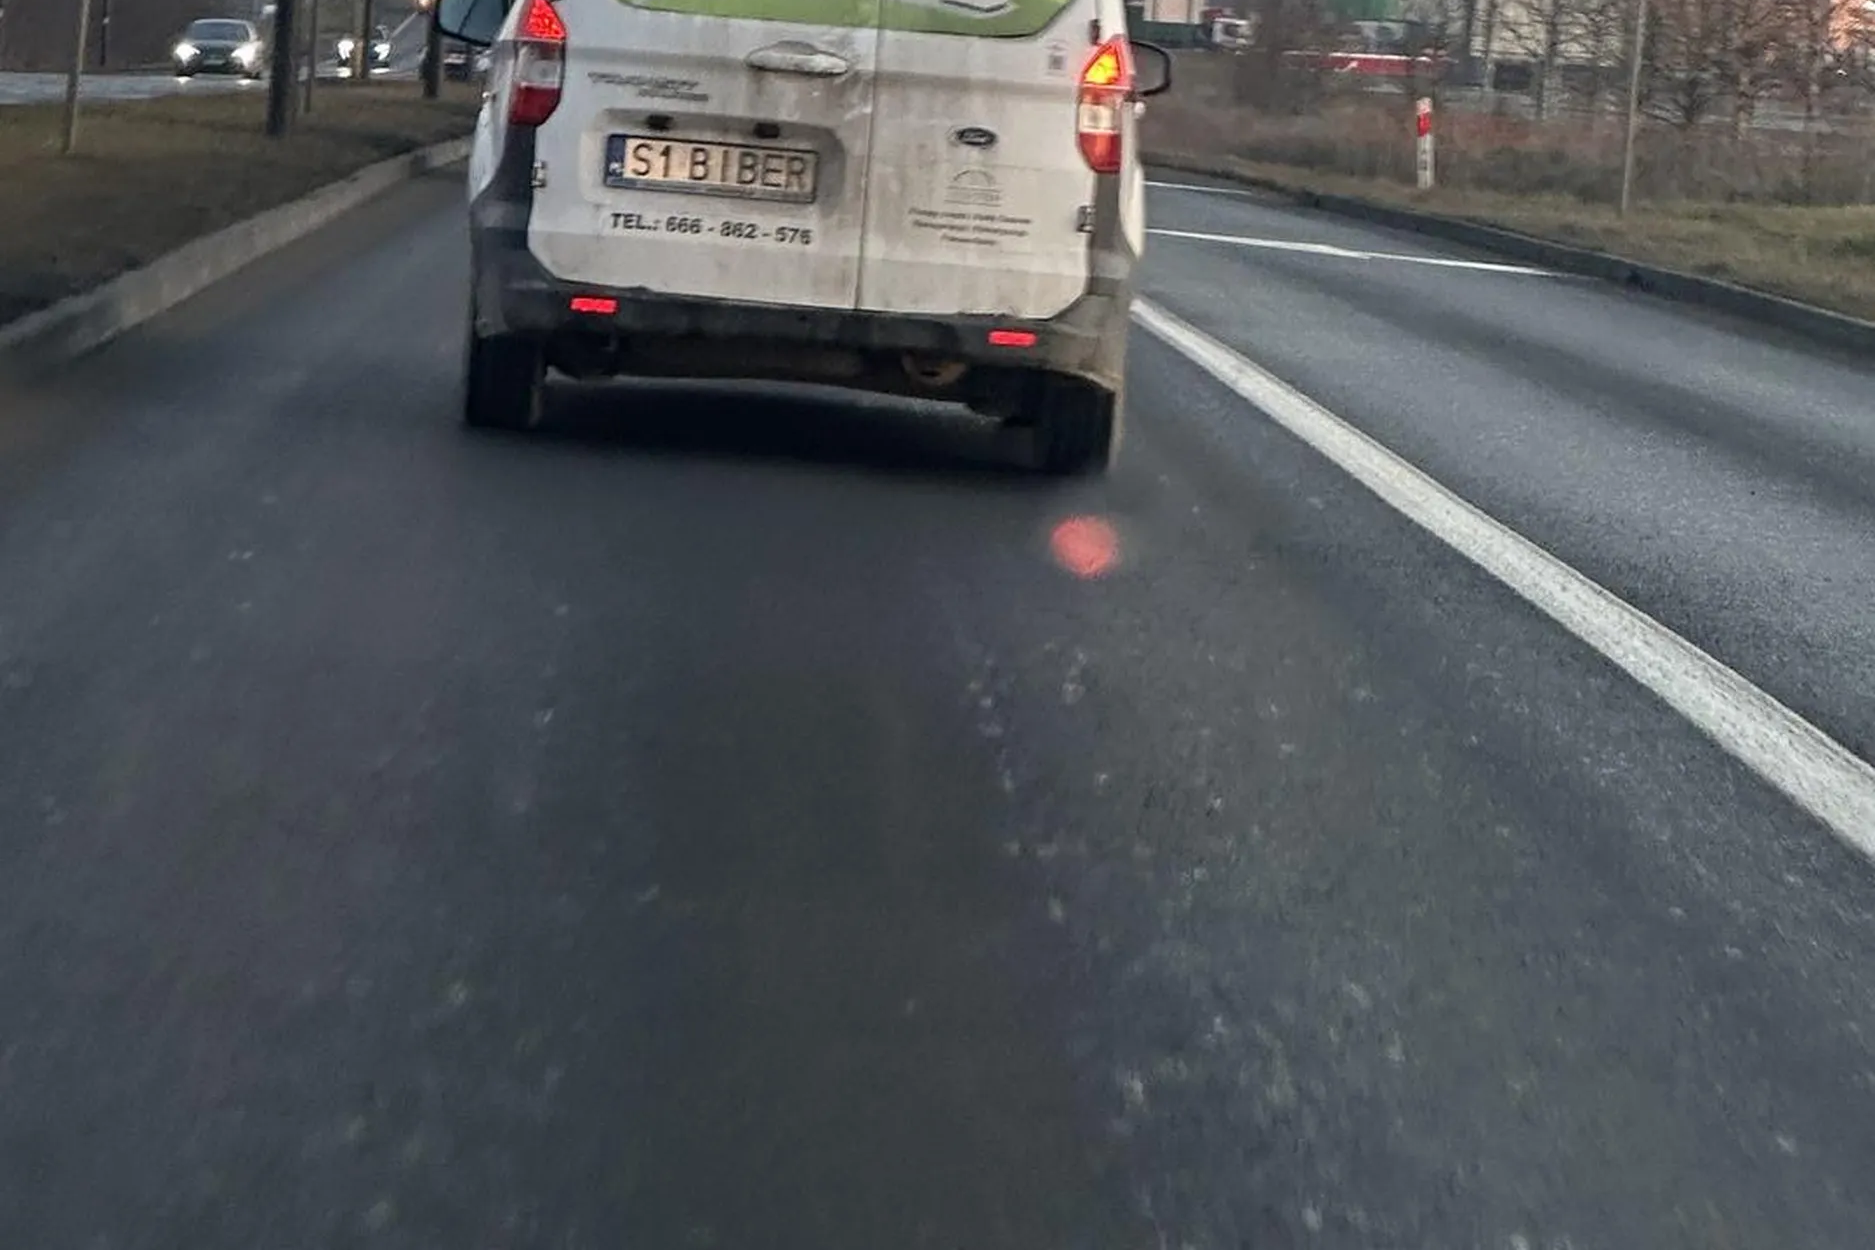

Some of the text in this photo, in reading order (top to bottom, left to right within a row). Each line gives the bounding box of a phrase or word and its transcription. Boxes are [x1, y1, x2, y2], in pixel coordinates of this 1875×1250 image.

[632, 143, 806, 191] S1 BIBER
[666, 216, 702, 234] 666
